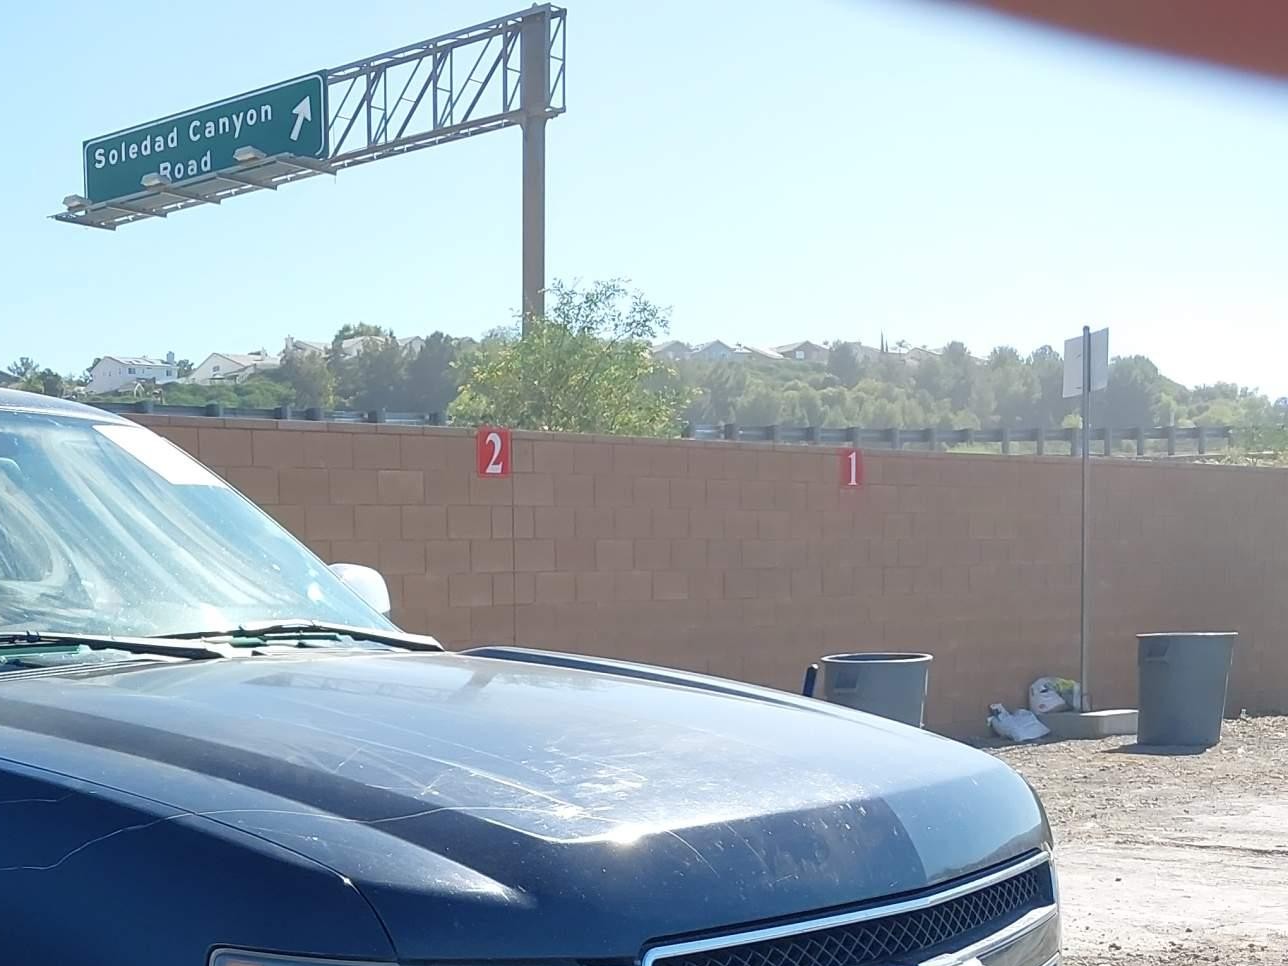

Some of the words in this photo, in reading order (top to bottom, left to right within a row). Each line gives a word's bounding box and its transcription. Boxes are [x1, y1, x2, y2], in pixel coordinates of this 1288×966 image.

[94, 126, 178, 169] Soledad
[188, 104, 272, 141] Canyon
[159, 149, 211, 182] Road
[485, 431, 504, 474] 2
[847, 451, 859, 486] 1
